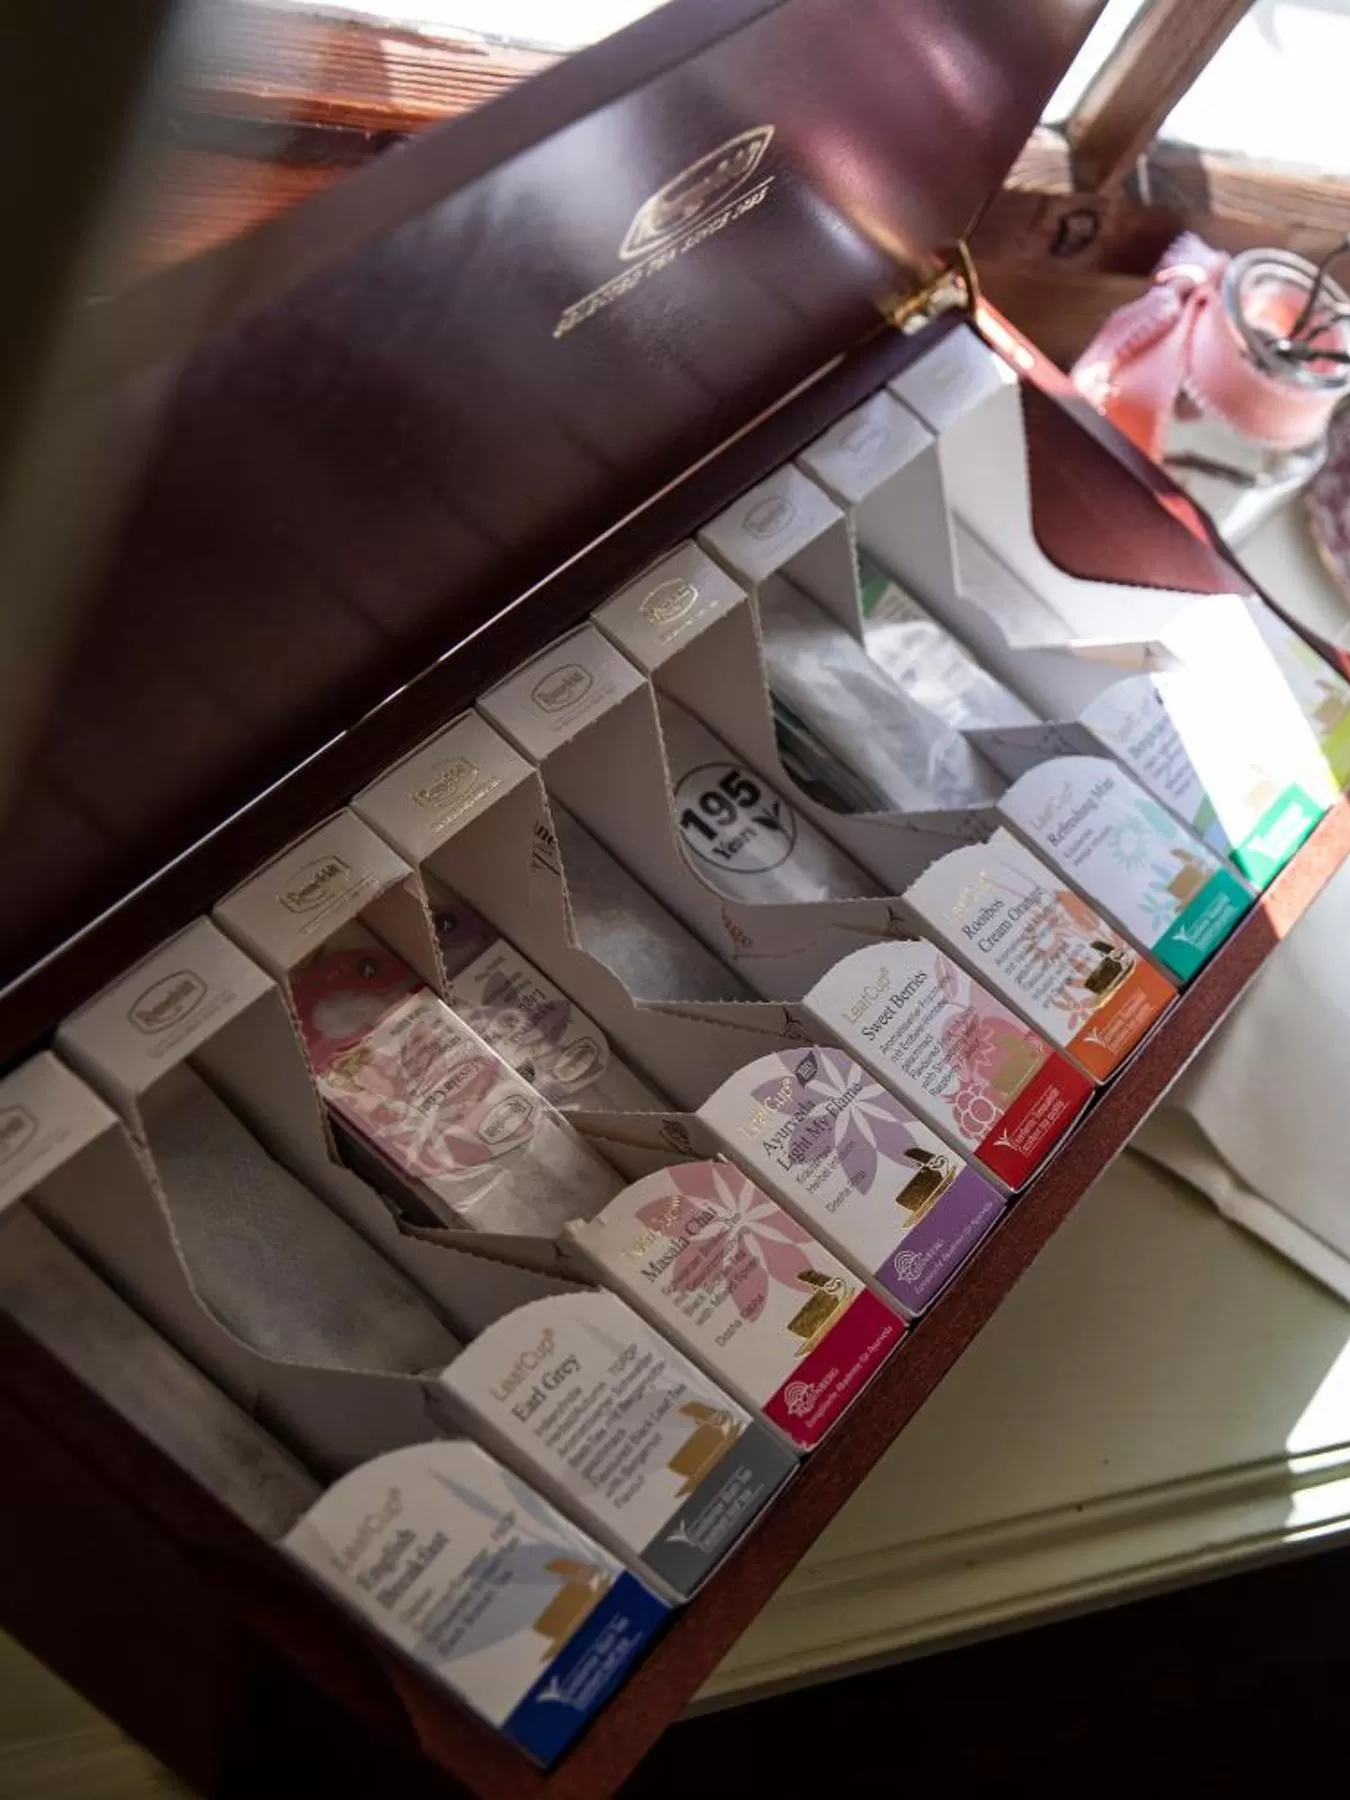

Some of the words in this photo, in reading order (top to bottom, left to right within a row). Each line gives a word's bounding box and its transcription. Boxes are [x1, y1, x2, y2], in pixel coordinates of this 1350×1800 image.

[676, 764, 762, 849] 195
[961, 894, 1004, 941] Rooibos
[976, 917, 1012, 955] Cream
[860, 1003, 896, 1042] Sweet
[889, 967, 928, 1009] Berries
[758, 1096, 816, 1160] Ayurveda
[776, 1132, 814, 1172] Light
[806, 1110, 833, 1138] My
[639, 1234, 690, 1284] Masala
[683, 1201, 718, 1239] Chai
[508, 1383, 547, 1424] Earl
[538, 1349, 583, 1393] Grey
